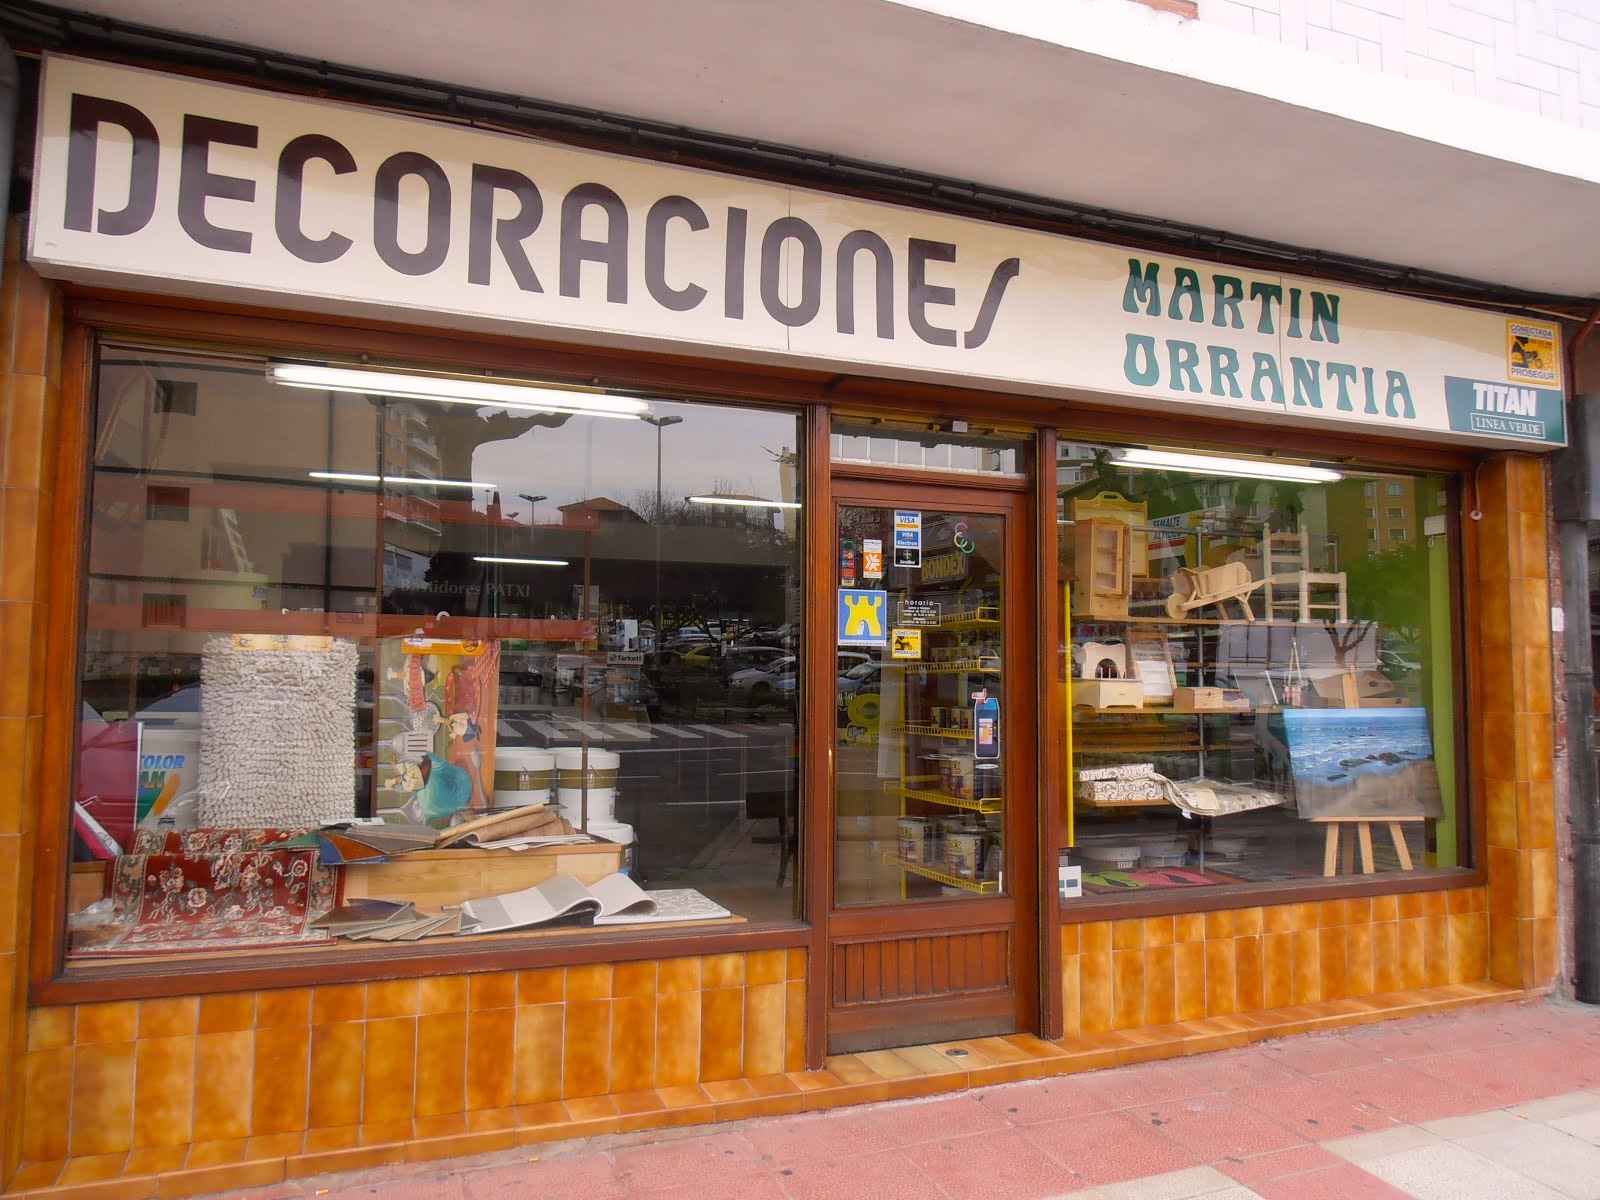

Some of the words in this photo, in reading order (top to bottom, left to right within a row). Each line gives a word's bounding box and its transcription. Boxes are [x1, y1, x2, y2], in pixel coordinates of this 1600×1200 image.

[63, 93, 1021, 350] DECORACIONES
[1122, 258, 1341, 344] MARTIN
[1510, 324, 1553, 336] CONECTADA
[1123, 333, 1417, 420] ORRANTIA
[1511, 367, 1555, 380] PROSEGUR
[1473, 382, 1537, 417] TITAN
[1476, 417, 1506, 430] LINEA
[1509, 421, 1541, 435] VERDE
[1152, 516, 1181, 527] ESMALTE
[921, 552, 965, 581] BONDEX
[401, 579, 481, 596] Bastidores
[617, 654, 642, 662] Tarkett
